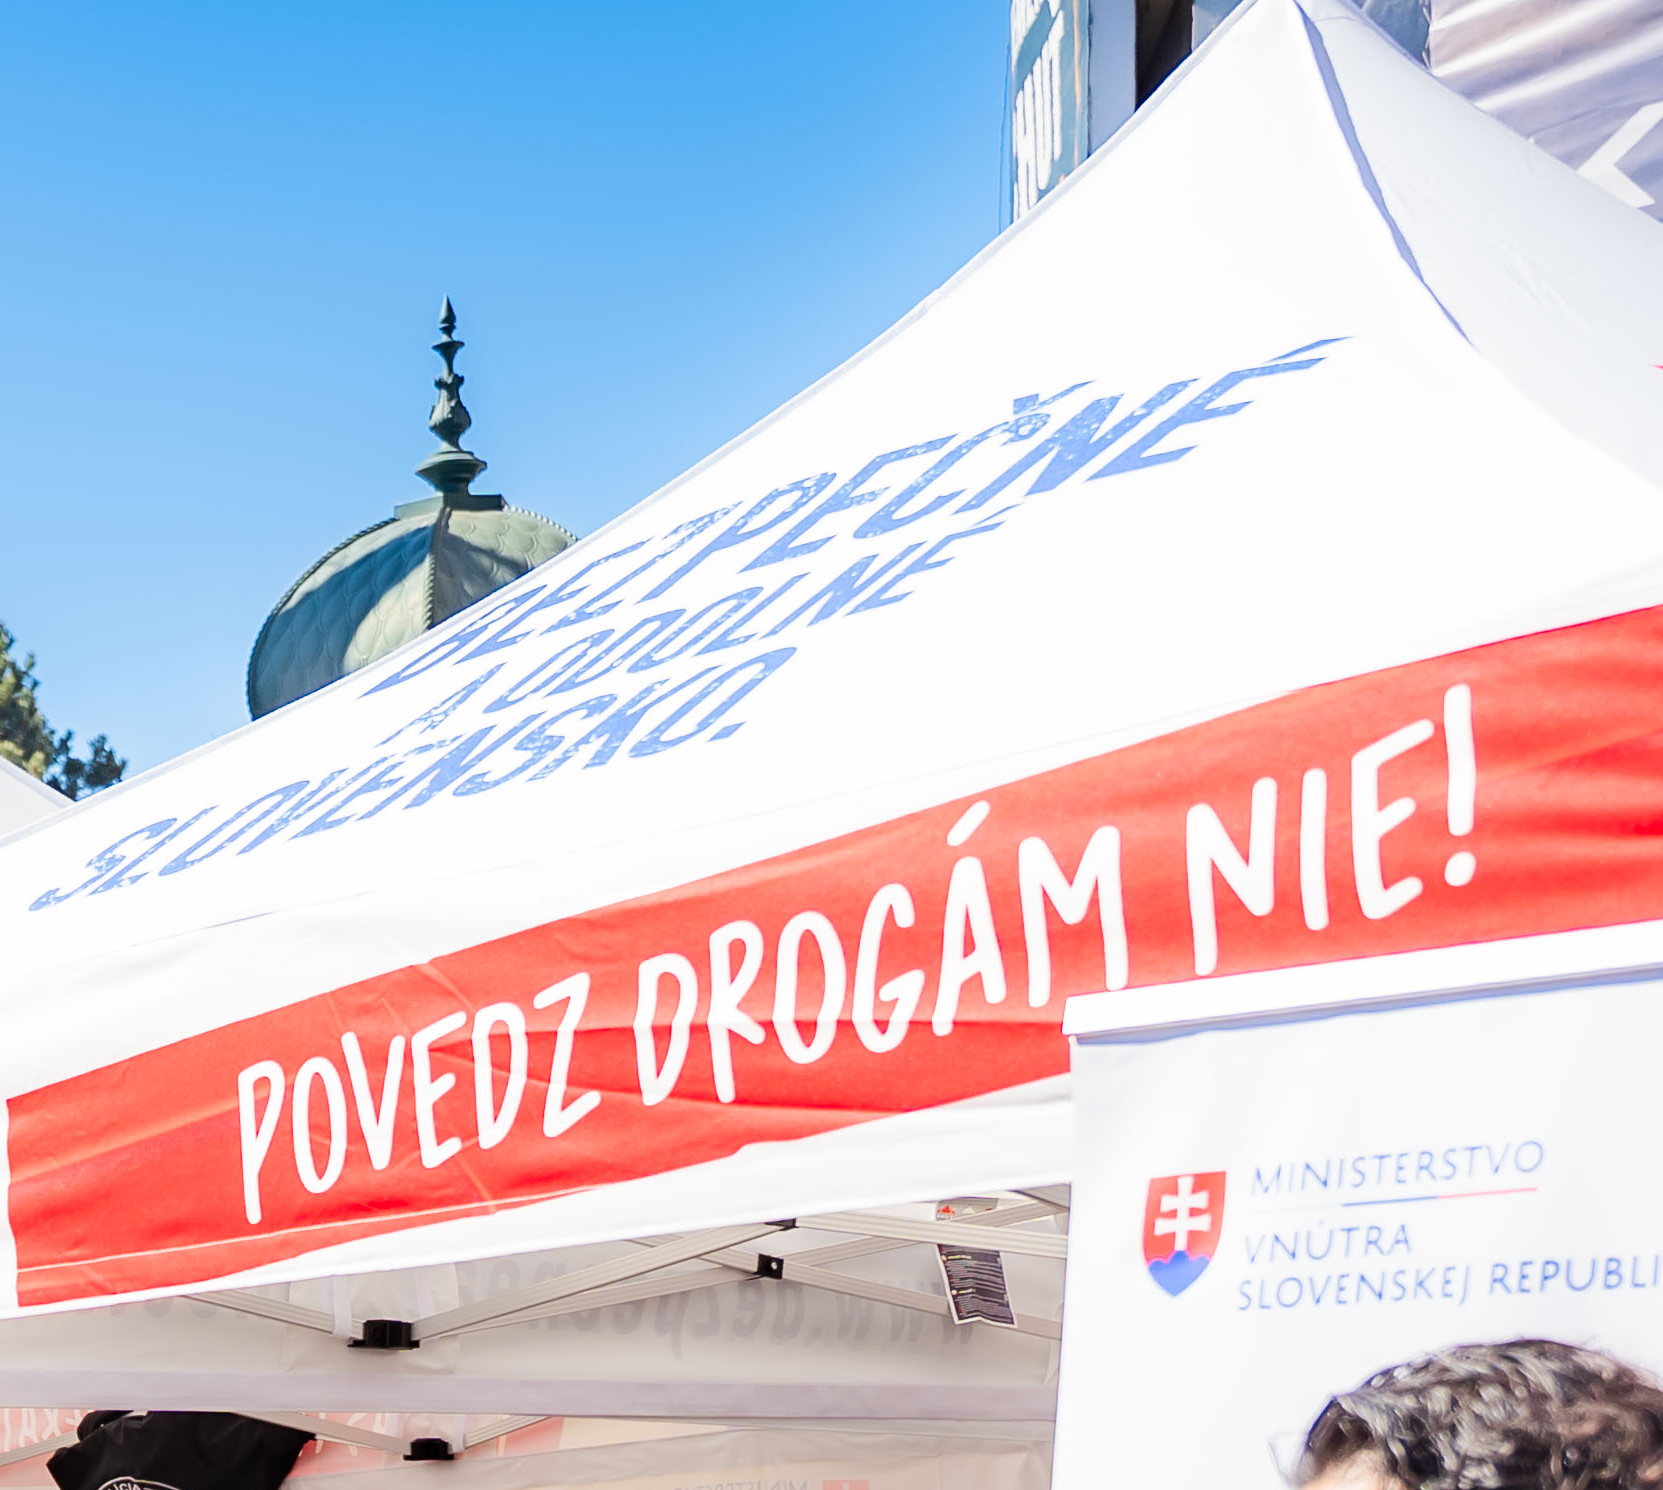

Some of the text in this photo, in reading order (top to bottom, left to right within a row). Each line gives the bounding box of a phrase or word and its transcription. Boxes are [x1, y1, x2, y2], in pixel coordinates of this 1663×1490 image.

[237, 972, 603, 1226] POVEDZ
[633, 800, 1130, 1105] DROGÁM
[1185, 682, 1478, 978] NIE!
[1251, 1139, 1545, 1198] MINISTERSTVO
[1244, 1219, 1413, 1265] VNÚTRA
[1236, 1264, 1471, 1312] SLOVENSKEJ
